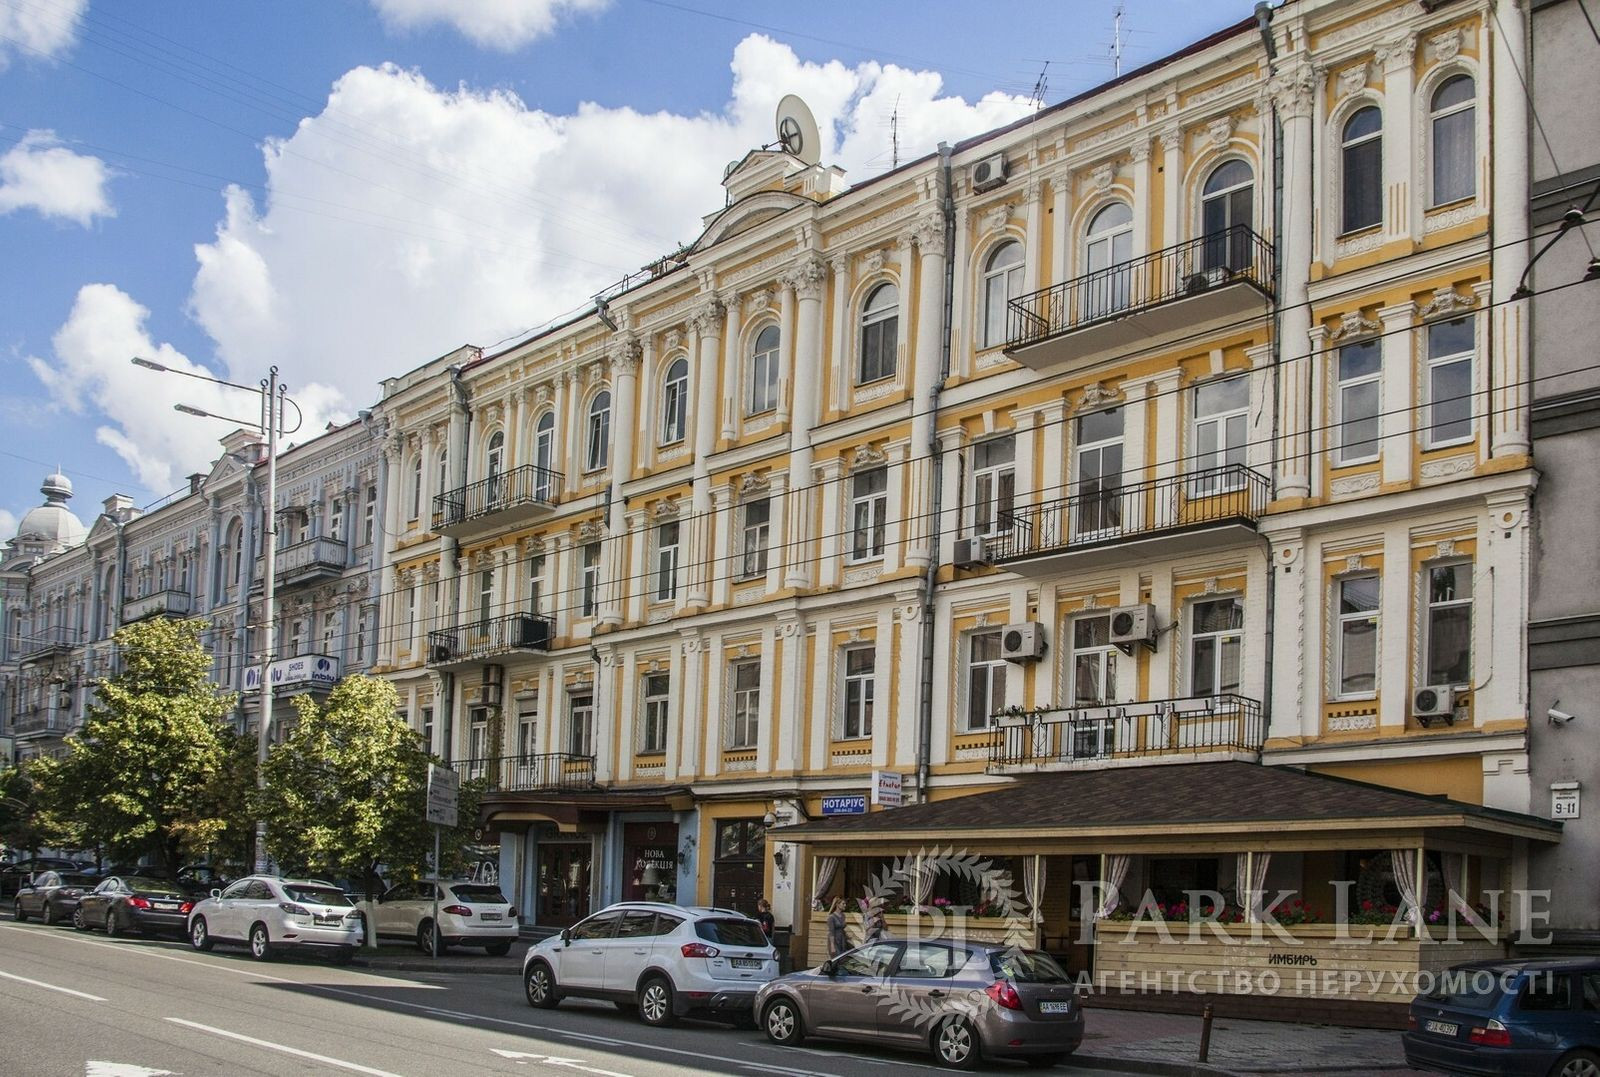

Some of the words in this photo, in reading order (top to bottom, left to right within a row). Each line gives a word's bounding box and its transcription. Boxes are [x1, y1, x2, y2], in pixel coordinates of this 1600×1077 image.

[289, 661, 304, 671] SHOES
[256, 668, 282, 684] ilu
[312, 671, 335, 681] inblu
[823, 798, 864, 809] НОТАРІУС
[1555, 803, 1575, 814] 9-11
[644, 849, 665, 858] НОВА
[1268, 953, 1318, 966] ИМБИРЬ
